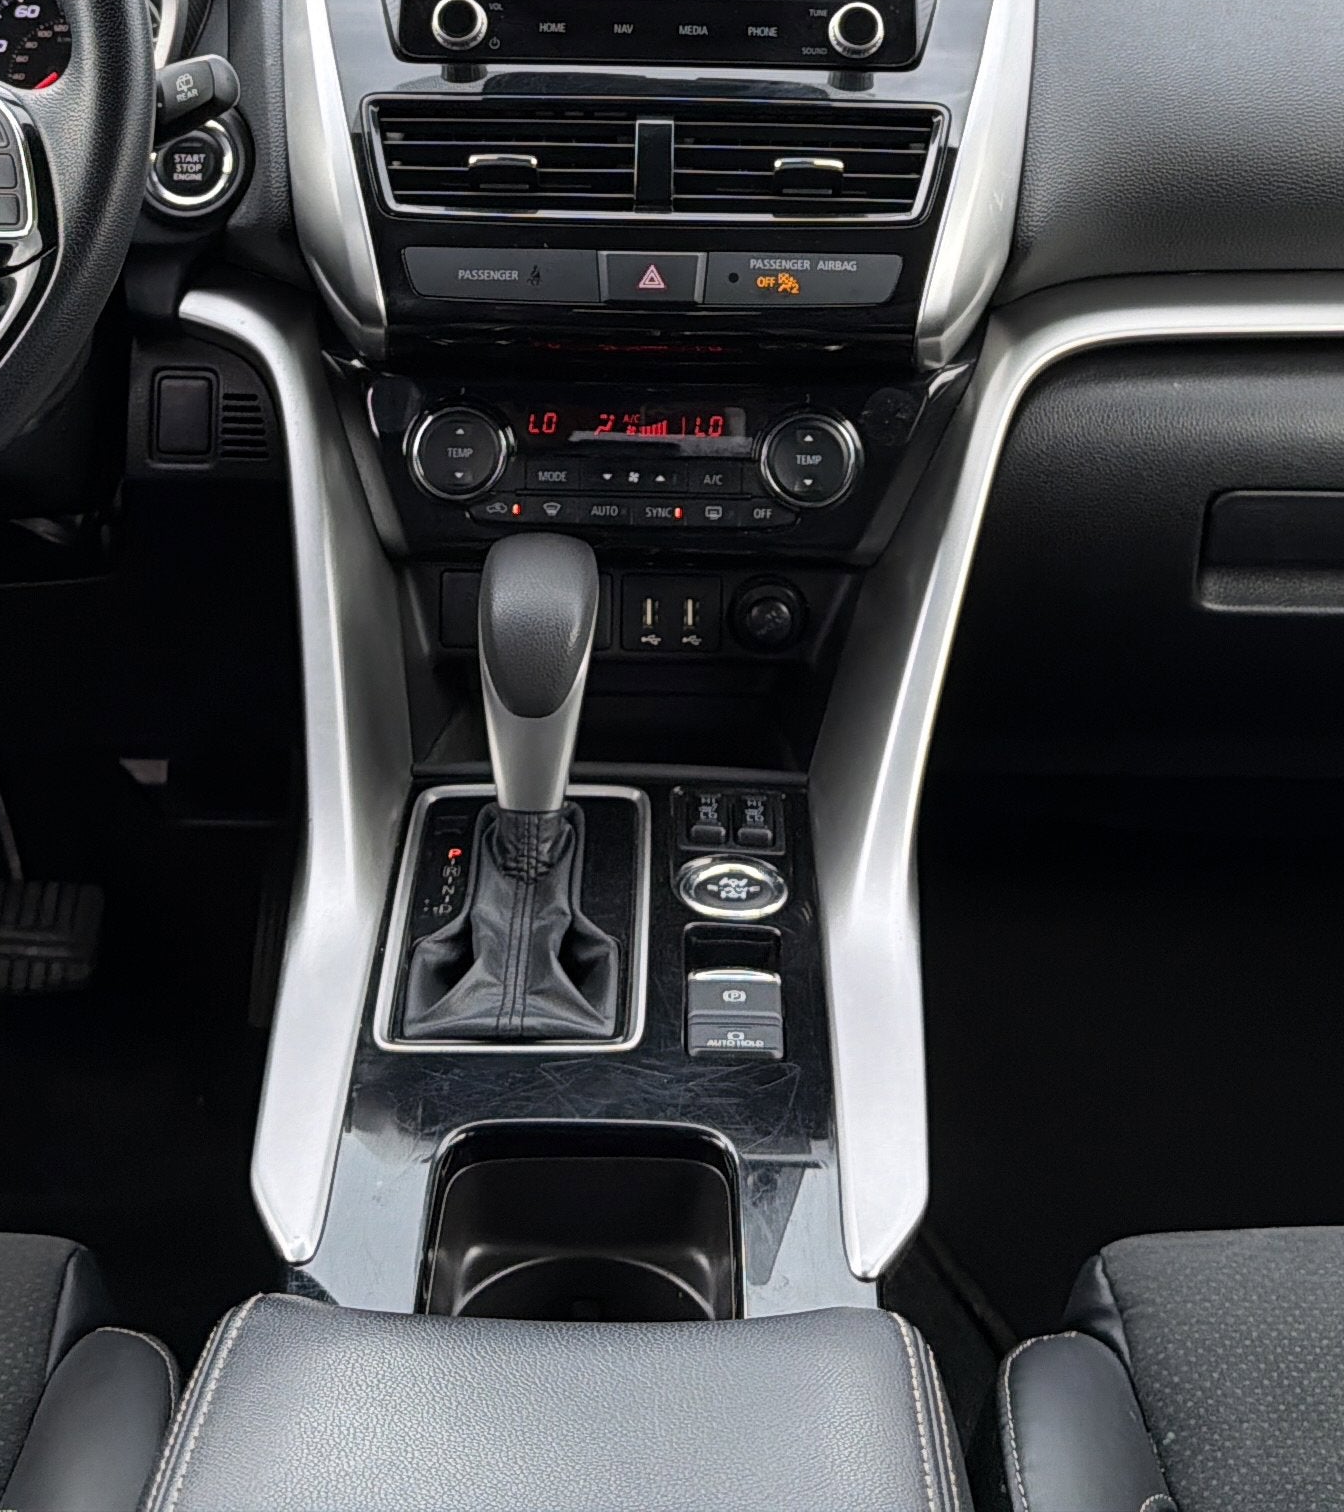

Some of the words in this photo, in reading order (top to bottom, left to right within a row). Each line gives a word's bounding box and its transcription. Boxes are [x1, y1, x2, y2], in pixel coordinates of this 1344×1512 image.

[14, 4, 41, 19] 60
[488, 2, 504, 11] VOL
[809, 8, 829, 18] TUNE
[538, 22, 566, 33] HOME
[613, 23, 634, 34] NAV
[678, 24, 709, 36] MEDIA
[747, 26, 778, 37] PHONE
[801, 46, 828, 55] SOUND
[175, 89, 199, 103] REAR
[173, 153, 206, 164] START
[175, 163, 202, 173] STOP
[172, 172, 203, 182] ENGINE
[749, 258, 811, 271] PASSENGER
[816, 259, 858, 272] AIRBAG
[457, 268, 519, 281] PASSENGER
[756, 275, 776, 289] OFF
[622, 413, 641, 424] A/C
[446, 447, 474, 459] TEMP
[795, 454, 823, 466] TEMP
[537, 470, 568, 483] MODE
[702, 473, 724, 486] A/C
[590, 505, 619, 517] AUTO
[644, 506, 672, 518] SYNC
[752, 508, 773, 520] OFF
[448, 847, 463, 859] P
[441, 885, 455, 896] N
[706, 1039, 736, 1048] AUTO
[736, 1039, 765, 1048] HOLD
